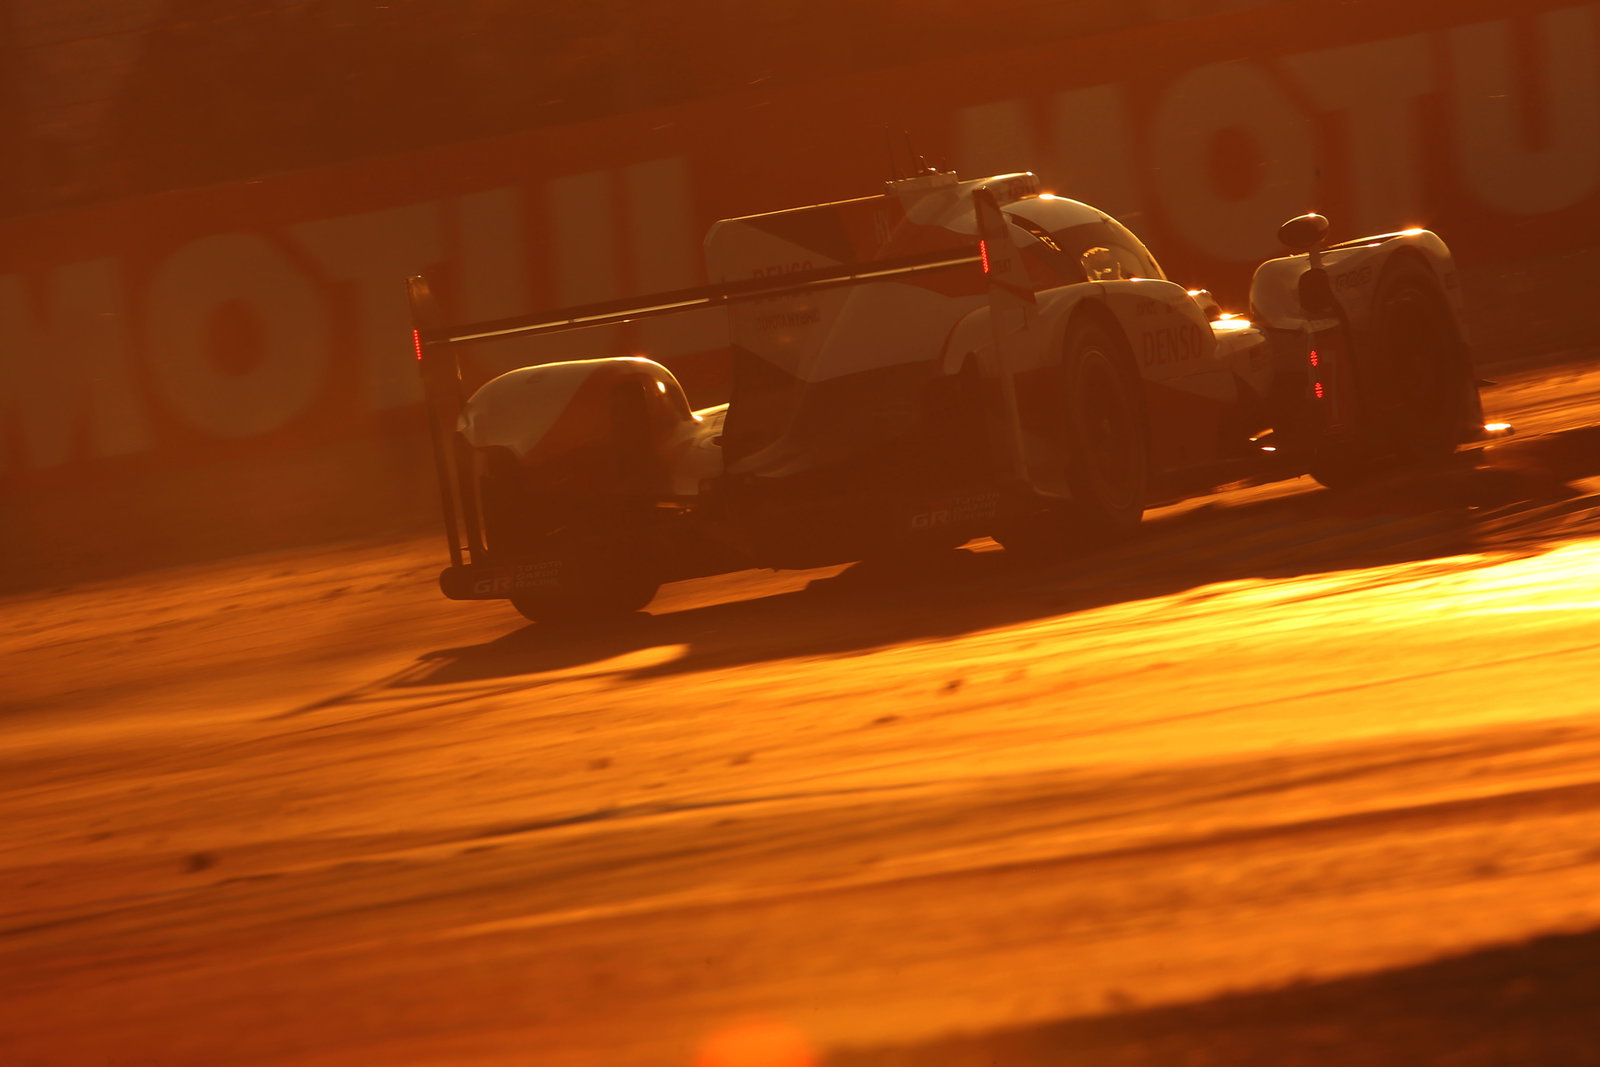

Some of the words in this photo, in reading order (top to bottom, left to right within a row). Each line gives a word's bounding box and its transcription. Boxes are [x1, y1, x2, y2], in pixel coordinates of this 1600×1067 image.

[1142, 322, 1203, 368] DENSO
[911, 509, 948, 528] GR
[473, 575, 513, 594] GR
